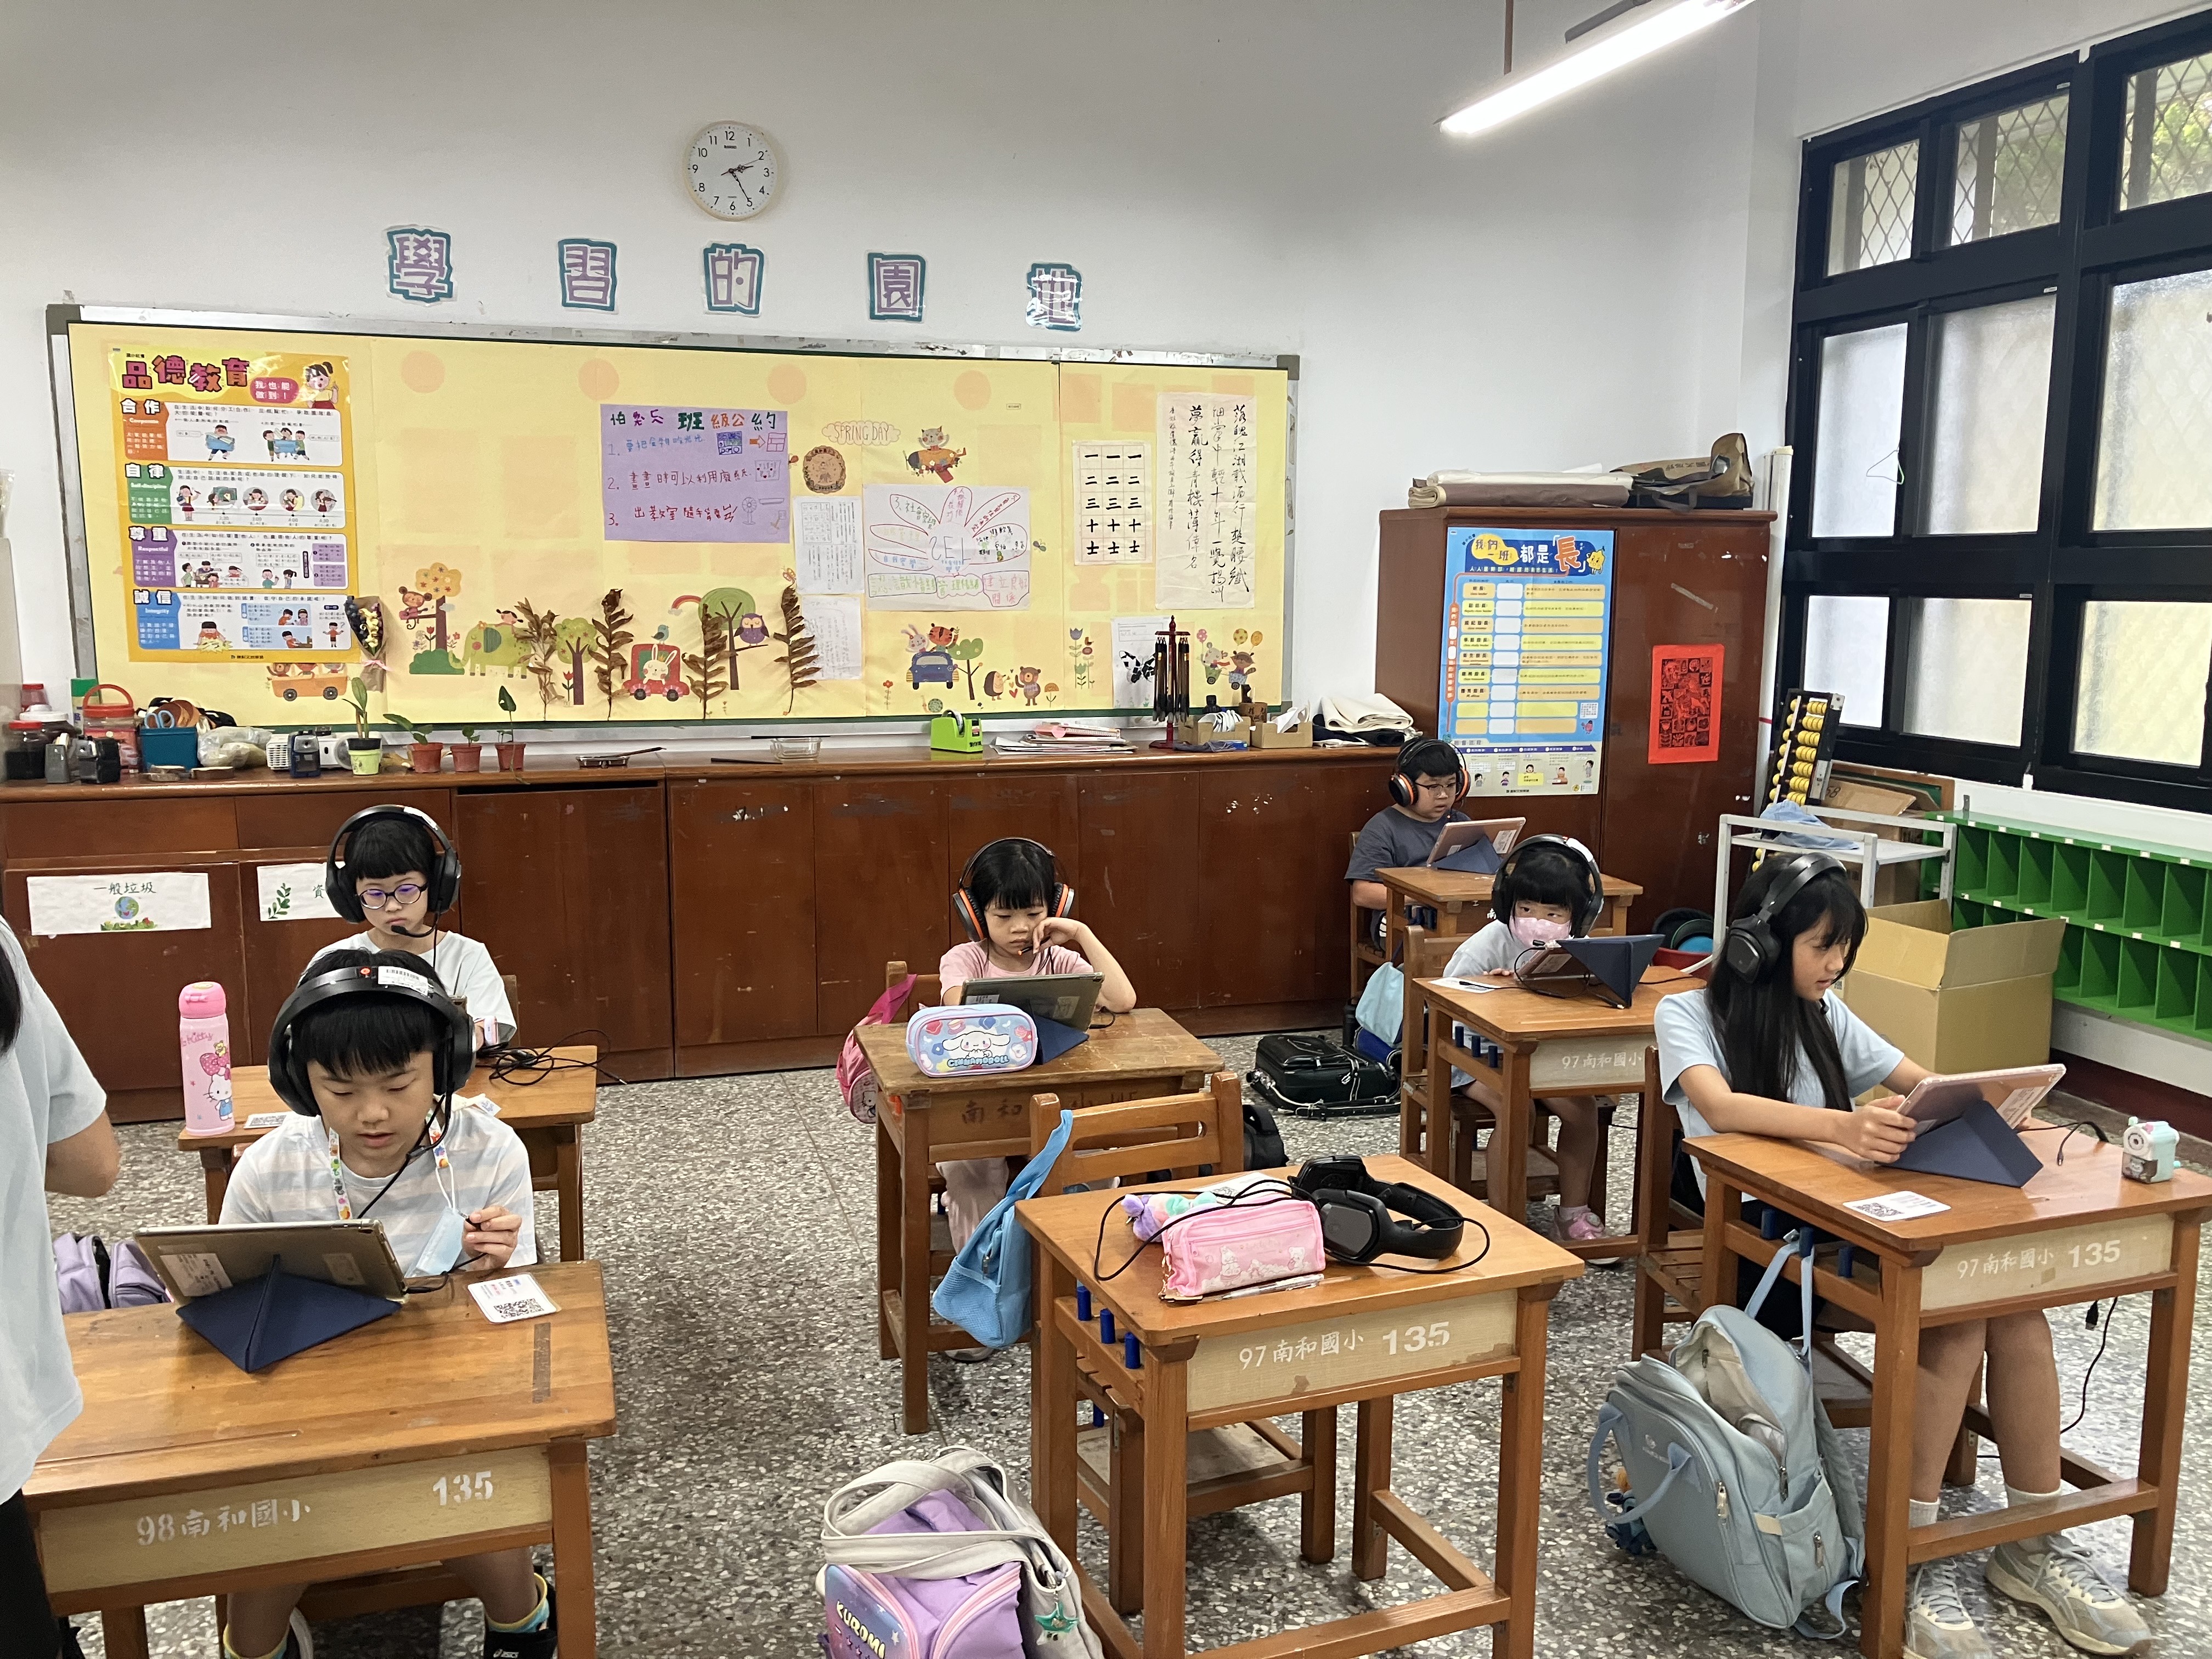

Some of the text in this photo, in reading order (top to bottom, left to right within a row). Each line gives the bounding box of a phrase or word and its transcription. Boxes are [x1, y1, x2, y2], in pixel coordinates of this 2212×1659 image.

[725, 131, 735, 140] 12
[709, 136, 717, 145] 11
[747, 137, 751, 146] 1
[698, 148, 708, 157] 10
[758, 151, 764, 160] 2
[692, 164, 698, 173] 9
[764, 168, 770, 177] 3
[698, 183, 706, 192] 8
[759, 185, 765, 194] 4
[714, 196, 719, 205] 7
[747, 198, 753, 207] 5
[730, 201, 736, 211] 6
[122, 354, 249, 392] 品德教育
[120, 398, 161, 415] 合作
[834, 425, 889, 441] SPRING DAY
[125, 462, 165, 479] 自律
[1520, 544, 1550, 564] 都是
[94, 882, 156, 896] 一般垃圾
[2068, 1240, 2121, 1268] 135
[1383, 1321, 1450, 1355] 135
[432, 1471, 494, 1505] 135
